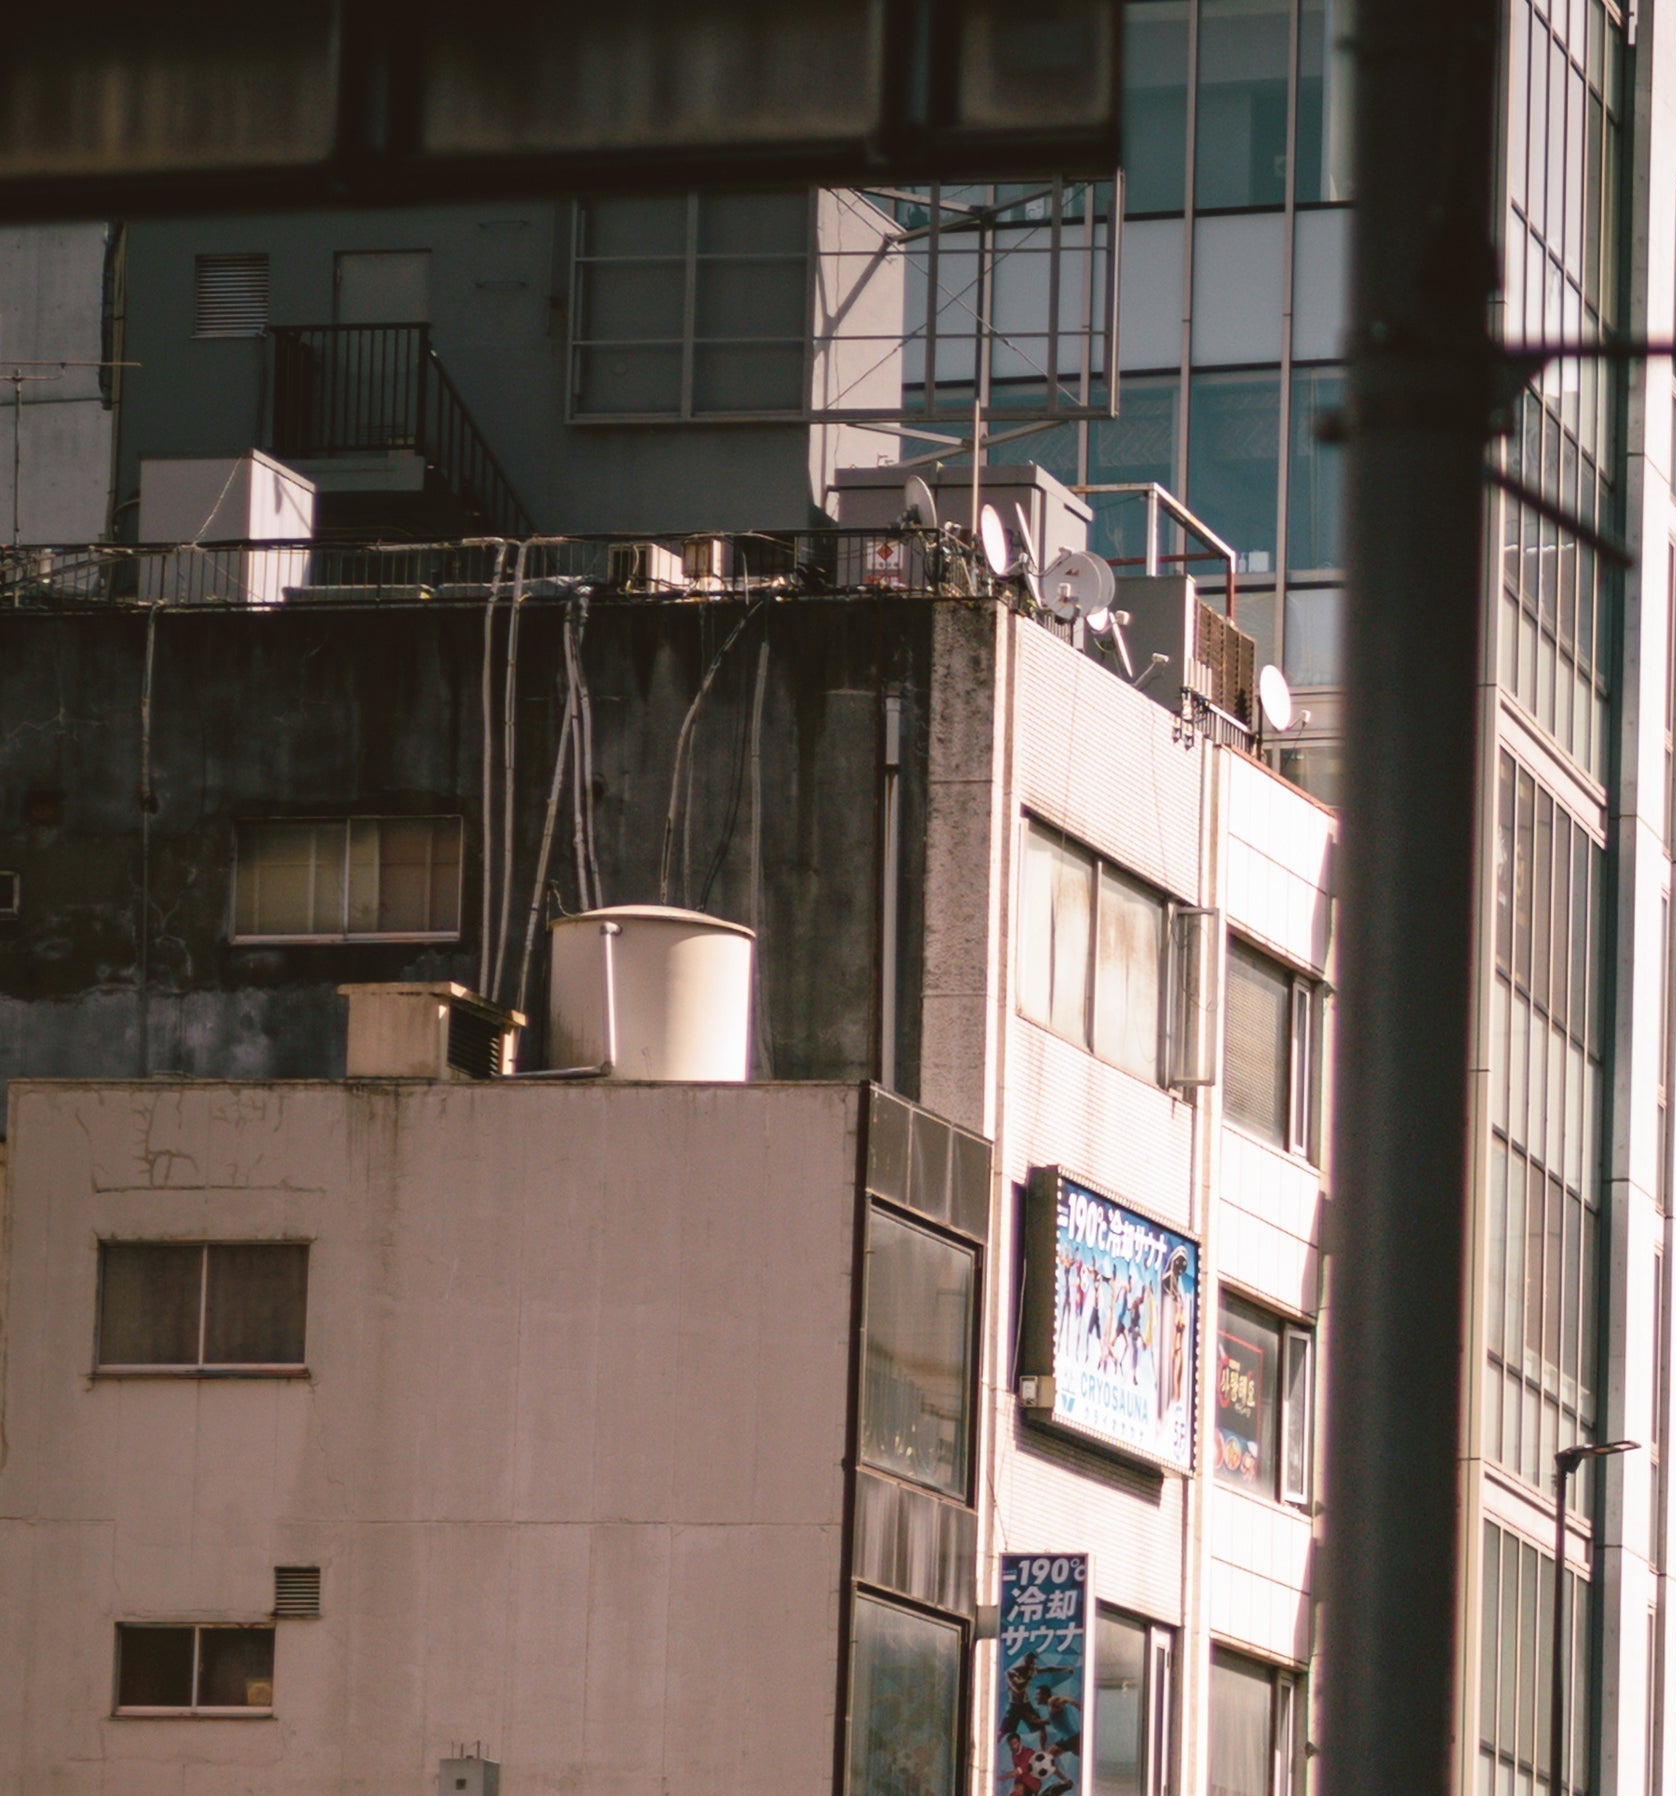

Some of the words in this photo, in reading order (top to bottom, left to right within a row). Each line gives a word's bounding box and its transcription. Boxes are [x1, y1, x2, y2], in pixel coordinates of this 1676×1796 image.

[1080, 1371, 1149, 1422] CRYOSAUNA
[1006, 1586, 1078, 1623] 冷却
[1001, 1621, 1084, 1656] サウナ
